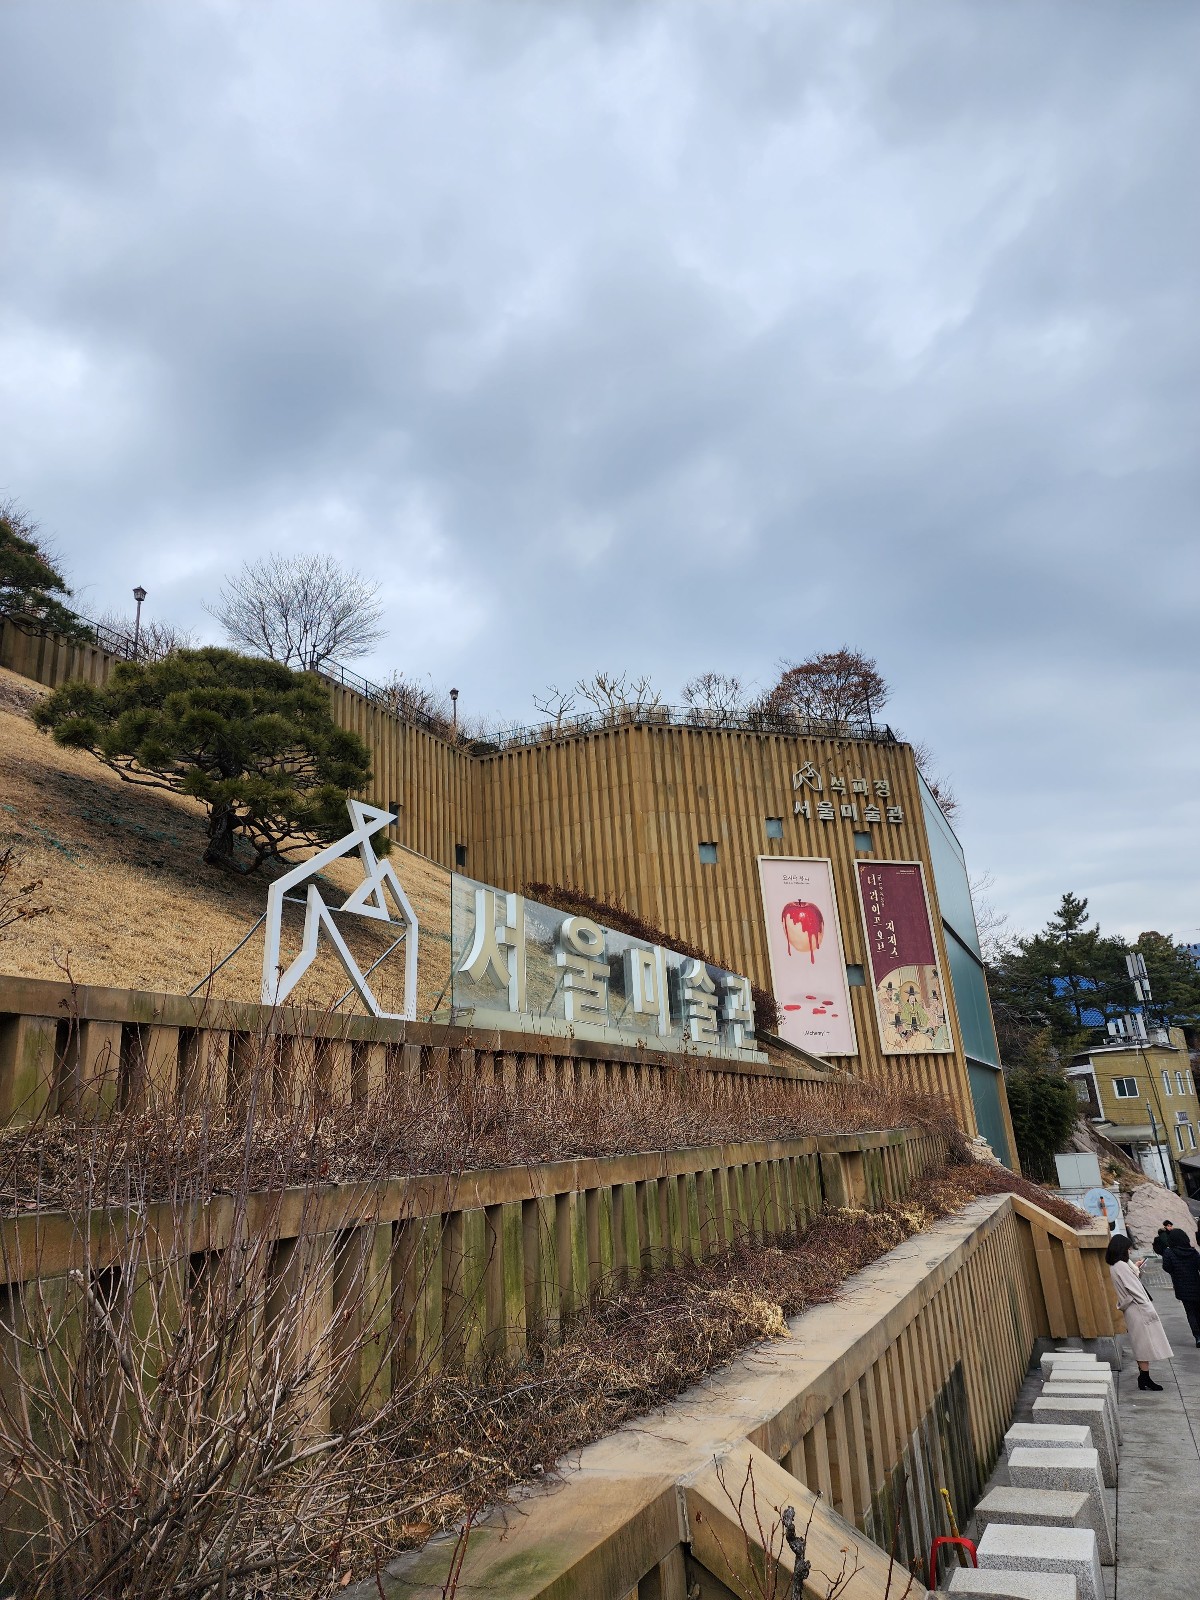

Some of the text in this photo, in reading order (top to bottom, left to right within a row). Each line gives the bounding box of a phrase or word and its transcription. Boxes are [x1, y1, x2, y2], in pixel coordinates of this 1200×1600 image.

[830, 776, 891, 797] 석파정
[793, 799, 905, 824] 서울미술관
[867, 873, 877, 886] 더
[869, 889, 883, 927] 라이프
[874, 929, 887, 953] 오브
[458, 888, 758, 1052] 서울미술관
